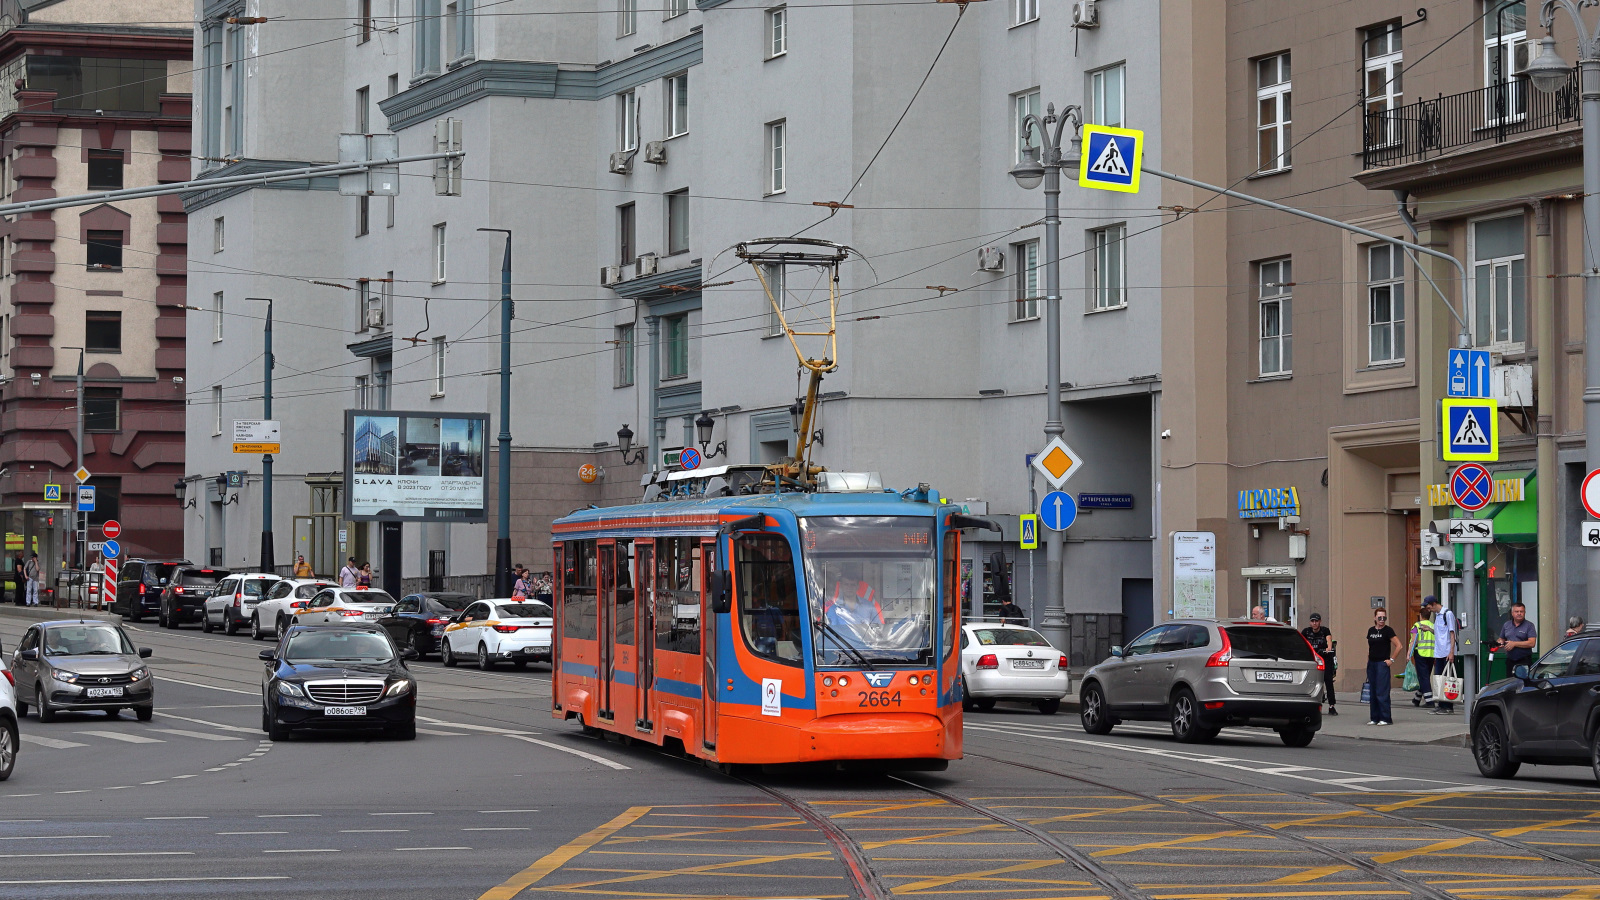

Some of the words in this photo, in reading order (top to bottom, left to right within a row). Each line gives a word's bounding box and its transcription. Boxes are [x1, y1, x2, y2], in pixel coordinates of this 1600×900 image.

[581, 467, 593, 476] 24
[1238, 487, 1298, 510] ИГРОВЕД
[804, 530, 816, 549] 9
[858, 690, 902, 708] 2664
